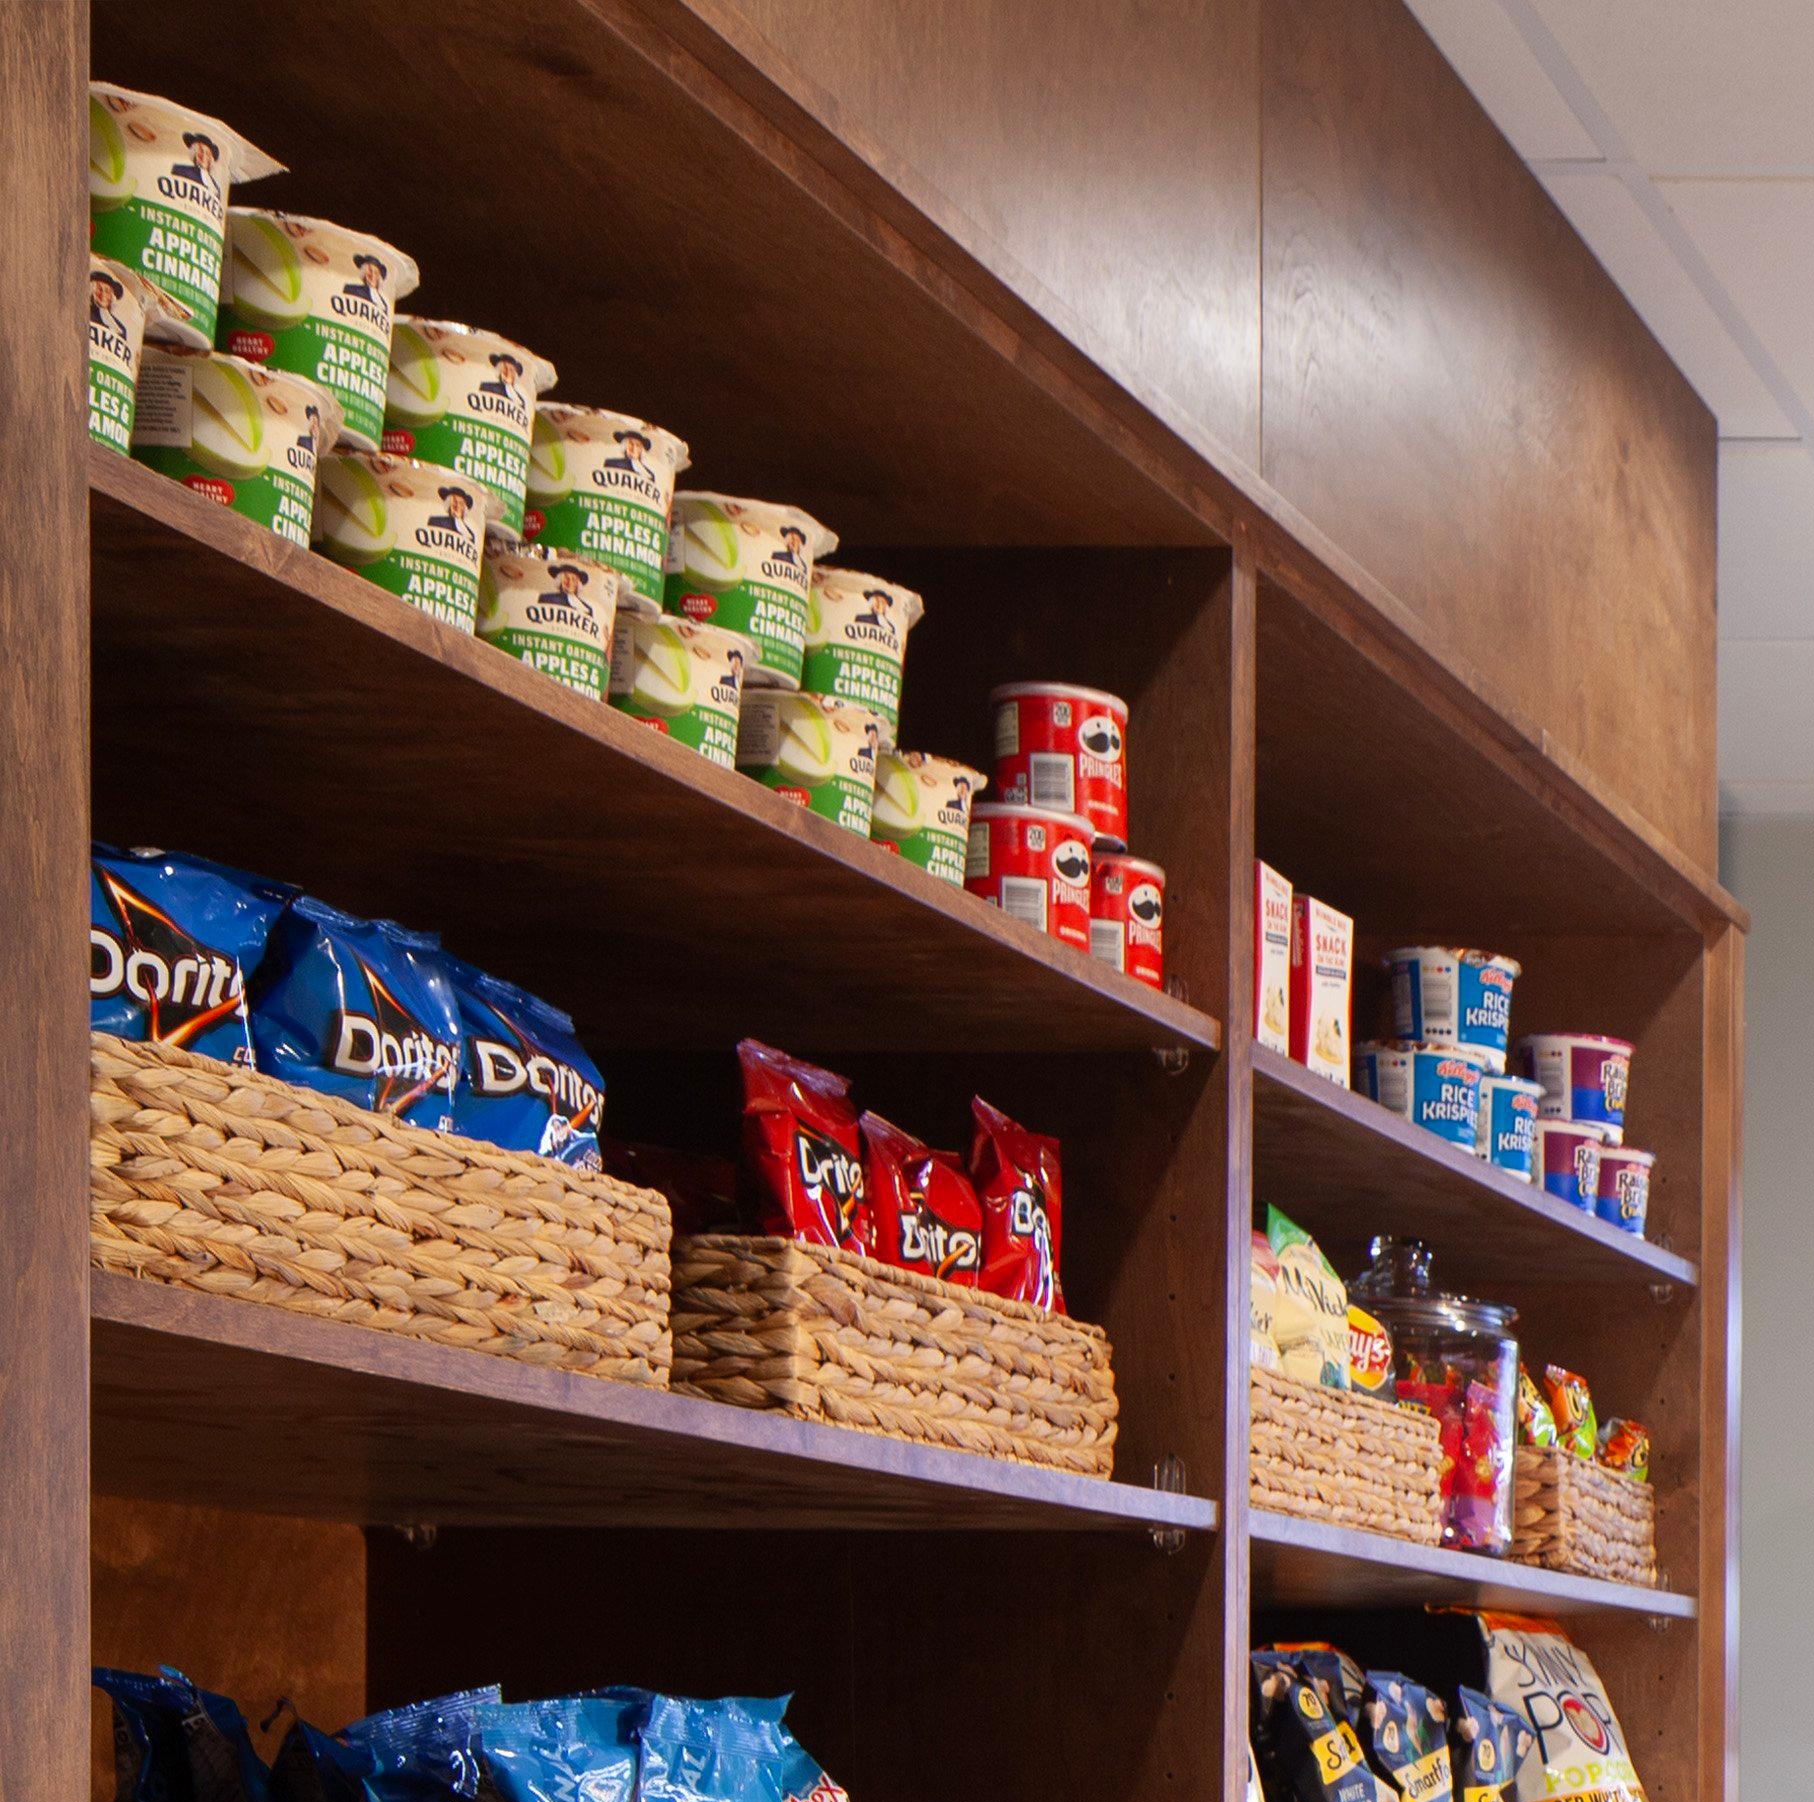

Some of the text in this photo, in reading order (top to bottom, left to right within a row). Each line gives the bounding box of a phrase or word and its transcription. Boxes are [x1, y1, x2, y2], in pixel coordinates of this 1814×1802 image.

[592, 470, 661, 502] QUAKER
[586, 509, 650, 542] APPLES
[526, 604, 599, 638] QUAKER
[520, 649, 588, 679] APPLES
[1316, 934, 1346, 956] SNACK
[1441, 1084, 1475, 1102] RICE
